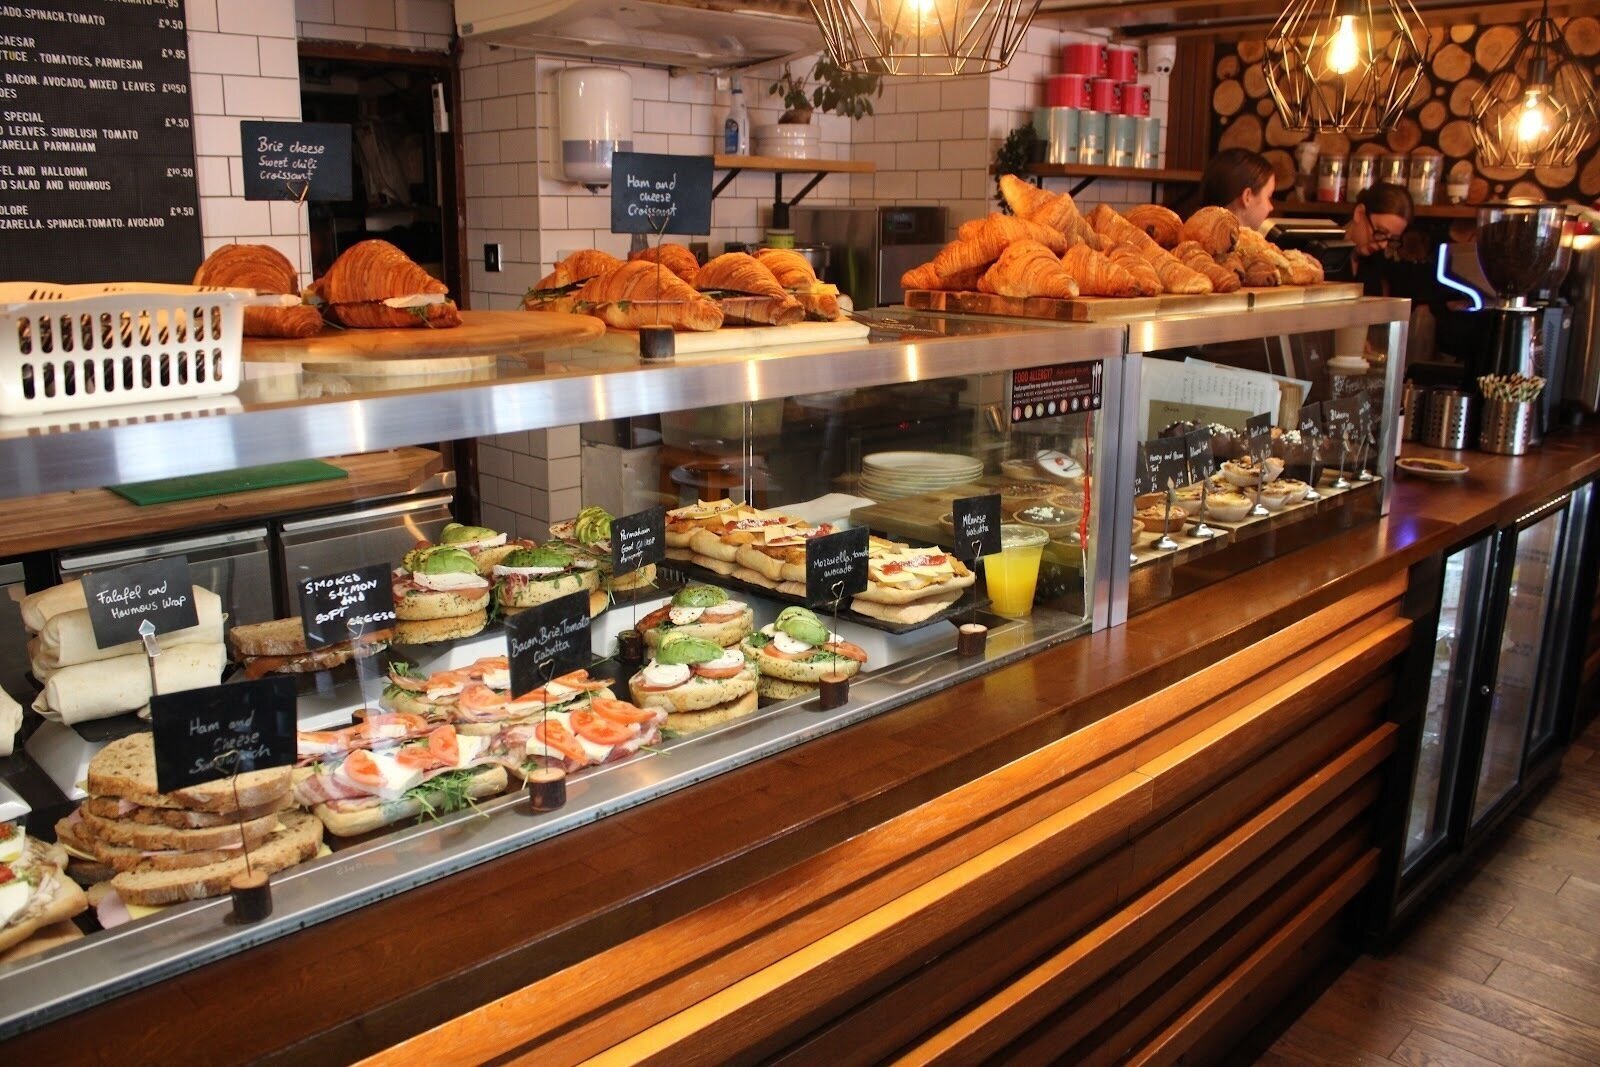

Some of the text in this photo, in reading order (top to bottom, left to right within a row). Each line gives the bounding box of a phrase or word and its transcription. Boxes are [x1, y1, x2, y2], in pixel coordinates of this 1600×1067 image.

[95, 57, 143, 70] PARMESAN
[89, 78, 118, 90] MIXED
[122, 81, 156, 92] LEAVES
[4, 111, 44, 123] SPECIAL
[51, 127, 98, 139] SUNBLUSH
[102, 129, 139, 140] TOMATO
[43, 141, 97, 152] PARMAHAM
[257, 136, 325, 154] Brie cheese
[258, 155, 318, 169] Sweet chili
[17, 166, 36, 176] AND
[41, 166, 88, 177] HALLOUMI
[10, 180, 41, 190] SALAD
[46, 180, 64, 190] AND
[69, 181, 112, 191] HOUMOUS
[627, 172, 677, 190] Ham and
[639, 192, 671, 202] cheese
[127, 218, 165, 228] AVOCADO
[96, 580, 167, 605] Falafel and
[111, 601, 158, 619] Houmous
[189, 709, 256, 737] Ham and
